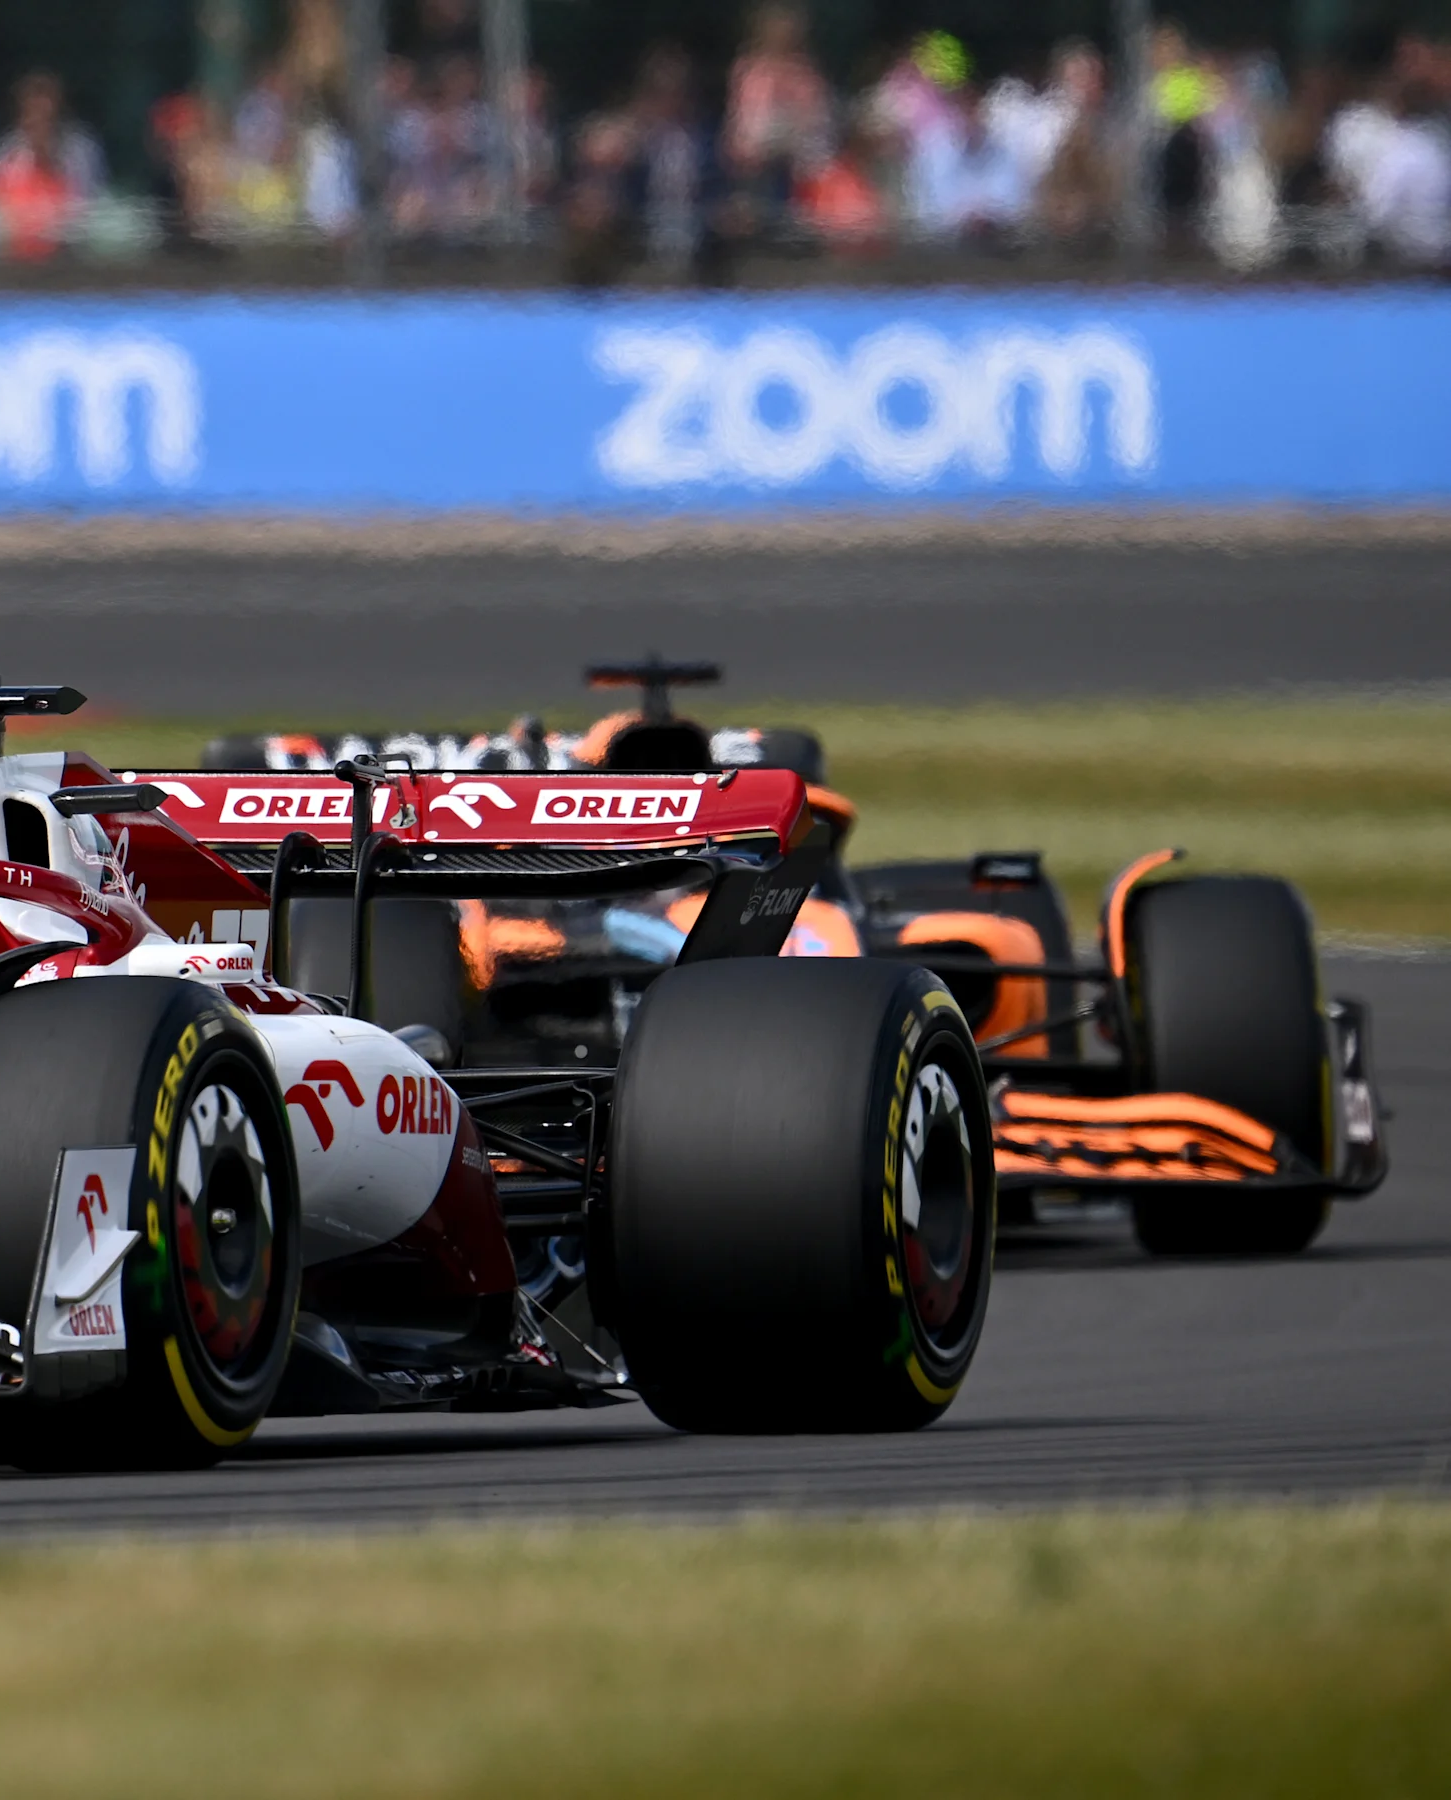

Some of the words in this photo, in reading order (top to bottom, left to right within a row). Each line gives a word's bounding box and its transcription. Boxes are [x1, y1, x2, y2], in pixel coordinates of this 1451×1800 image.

[593, 325, 1159, 489] zoom
[545, 795, 688, 818] ORLEN
[757, 887, 804, 916] FLOKI
[216, 957, 253, 970] ORLEN
[148, 1022, 199, 1192] ZERO
[376, 1074, 452, 1135] ORLEN
[882, 1049, 910, 1241] ZERO
[69, 1304, 116, 1336] ORLEN
